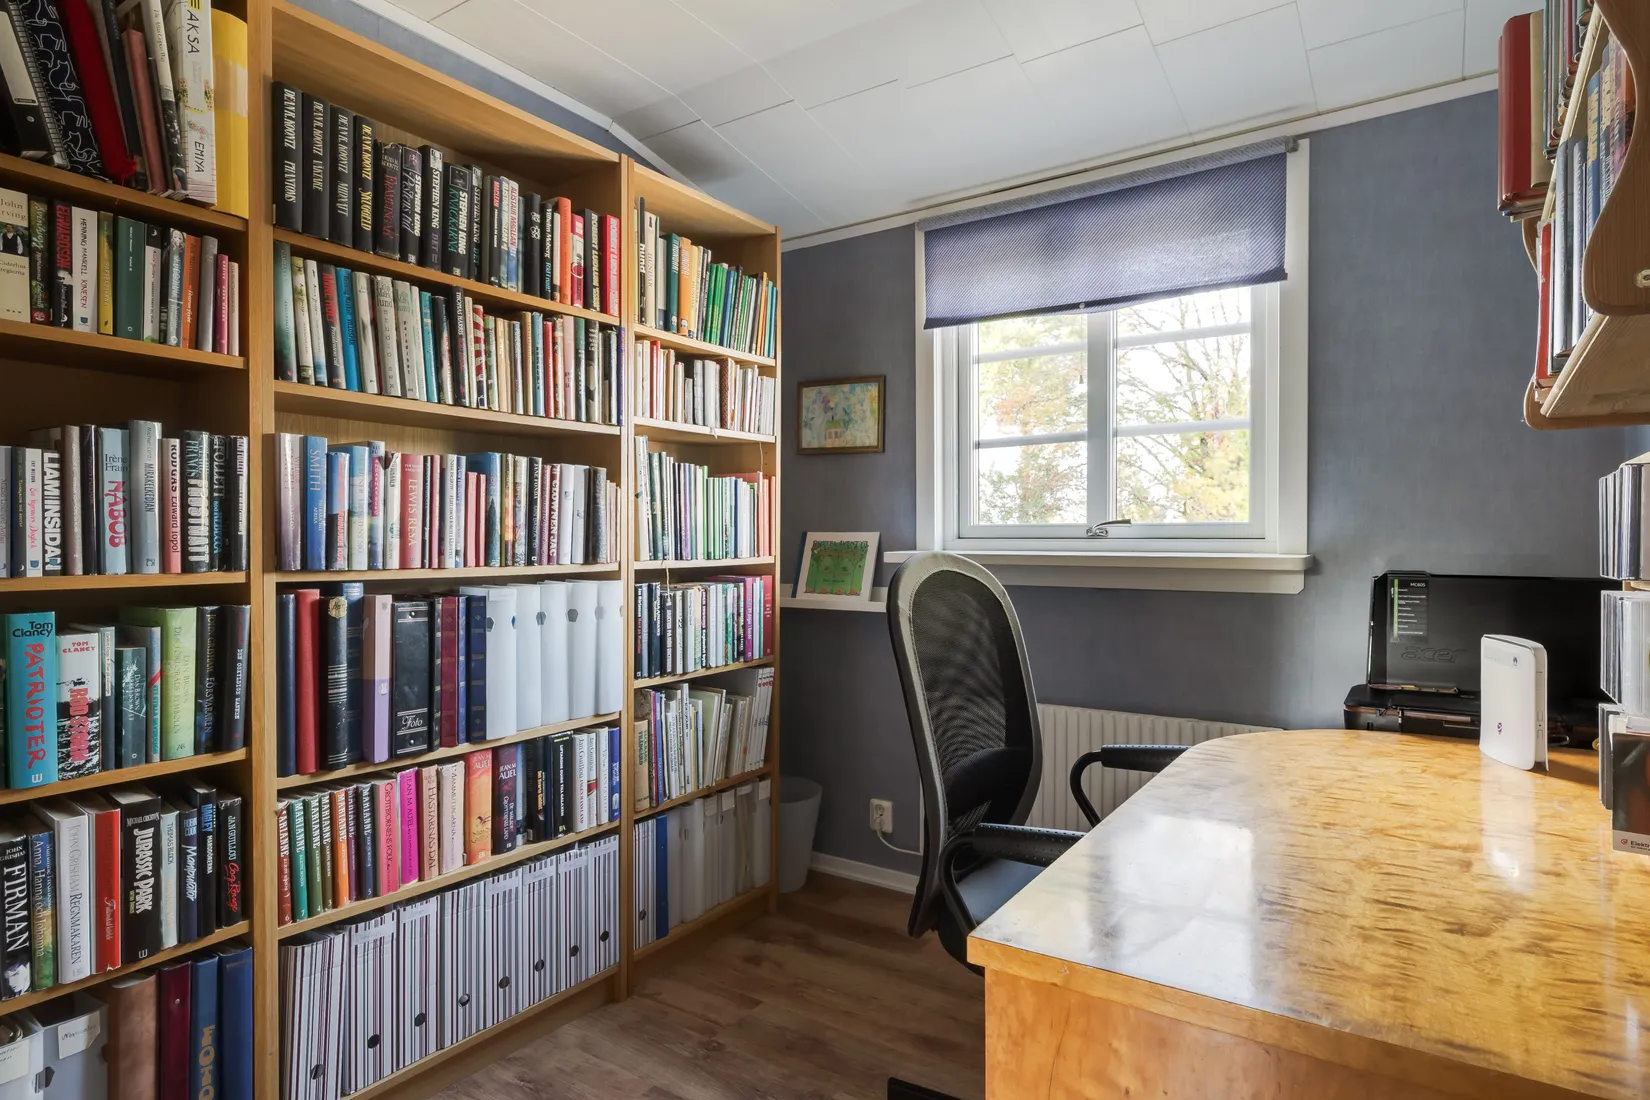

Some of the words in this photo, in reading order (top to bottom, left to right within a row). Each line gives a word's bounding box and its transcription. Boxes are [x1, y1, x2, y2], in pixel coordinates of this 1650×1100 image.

[187, 9, 200, 54] AKSA
[284, 88, 296, 110] DEAN
[313, 101, 324, 120] DEAN
[284, 118, 296, 149] KOONTZ
[338, 114, 349, 135] DEAN
[362, 124, 372, 144] DEAN
[193, 141, 205, 173] EMIYA
[313, 128, 324, 156] KOONTZ
[338, 144, 349, 174] KOONTZ
[362, 151, 372, 180] KOONTZ
[284, 160, 297, 203] PHANTOMS
[402, 171, 415, 212] Pestens
[414, 174, 422, 213] STEPHEN
[431, 169, 440, 207] STEPHEN
[0, 209, 27, 221] rving
[337, 181, 349, 218] MIDNATT
[359, 188, 373, 231] SKUGGELD
[458, 191, 469, 231] STEPHEN
[473, 186, 481, 222] STEPHEN
[32, 202, 47, 250] Svinhugg
[80, 218, 88, 247] HENNING
[402, 213, 415, 234] tid
[431, 207, 440, 229] KING
[448, 187, 459, 253] KNACKARNA
[473, 223, 481, 243] KING
[431, 232, 439, 252] DET
[458, 231, 468, 256] KING
[610, 218, 618, 253] ROBERT
[80, 247, 88, 276] MANKELL
[610, 254, 618, 289] LUDLUM
[80, 279, 88, 309] KINESEN
[322, 272, 335, 298] ANNE
[455, 292, 463, 315] THOMAS
[104, 454, 127, 463] Irène
[104, 463, 127, 472] Frain
[185, 440, 200, 477] FRANCIS
[213, 444, 226, 499] FOLLETT
[309, 449, 321, 492] SMITH
[144, 463, 154, 513] MIRAKELKEDJAN
[408, 478, 418, 514] LEWIS
[104, 480, 127, 548] NABOB
[188, 479, 209, 563] FROSTNATT
[551, 479, 559, 535] CLOWNEN
[213, 511, 223, 554] REBECCA
[408, 518, 417, 546] RESA
[549, 536, 558, 556] JAC
[12, 628, 53, 638] Clancy
[29, 621, 54, 631] Tom
[206, 614, 216, 636] JOHN
[62, 646, 96, 654] CLANCY
[183, 655, 191, 671] DAN
[206, 637, 215, 673] GRISHAM
[1401, 645, 1467, 663] acer
[23, 642, 46, 769] PATRIOTER
[68, 687, 92, 716] RÖD
[204, 677, 215, 733] FÖRSVARAREN
[402, 716, 423, 730] Foto
[69, 716, 89, 764] STORM
[406, 776, 414, 796] JEAN
[498, 769, 517, 780] AUEL
[362, 788, 373, 836] MARIANNE
[407, 797, 413, 805] M
[201, 803, 214, 832] BAGLEY
[228, 815, 236, 830] JAN
[295, 802, 305, 853] MARIANNE
[311, 799, 321, 849] MARIANNE
[321, 796, 331, 845] MARIANNE
[337, 793, 347, 842] MARIANNE
[69, 824, 82, 849] JOHN
[228, 830, 237, 861] GUILLOU
[278, 811, 290, 858] ARIANNE
[5, 845, 23, 856] JOHN
[32, 839, 45, 867] Anna,
[133, 827, 155, 878] JURASSIC
[206, 834, 214, 875] MARODÖRERNA
[428, 849, 436, 872] DAL
[34, 869, 45, 901] Hanna
[68, 849, 82, 893] GRISHAM
[181, 845, 198, 901] Manipulator
[223, 862, 240, 883] Coq
[3, 860, 30, 953] FIRMAN
[35, 901, 45, 918] och
[133, 877, 155, 915] PARK
[226, 882, 241, 912] Rouge
[35, 918, 47, 957] Johanna
[69, 893, 83, 965] REGNMAKAREN
